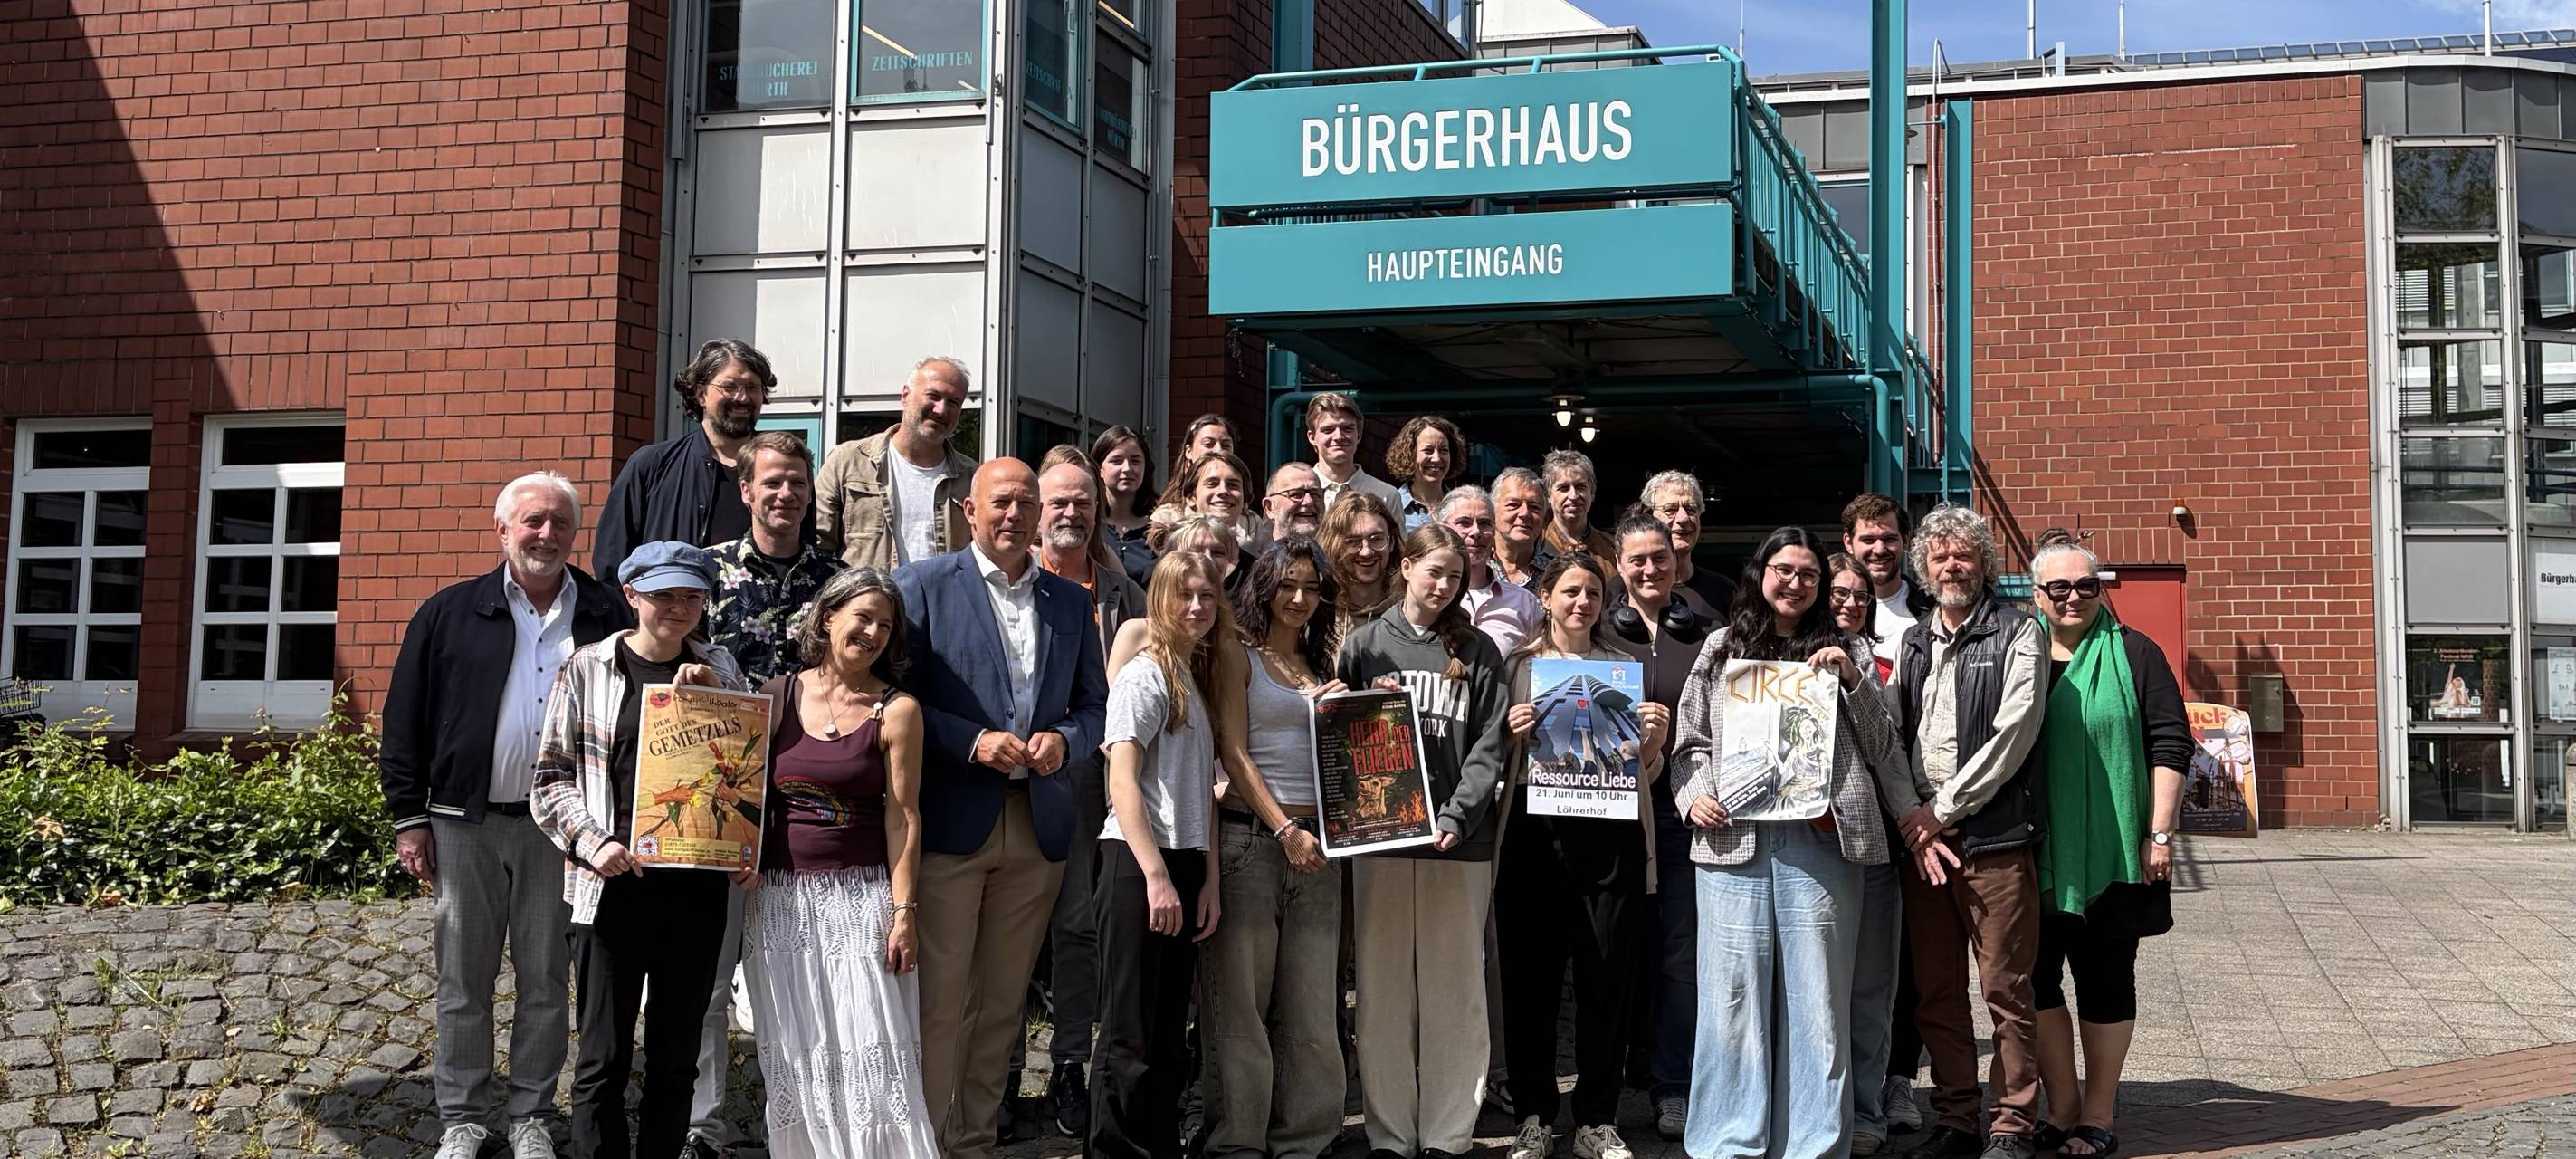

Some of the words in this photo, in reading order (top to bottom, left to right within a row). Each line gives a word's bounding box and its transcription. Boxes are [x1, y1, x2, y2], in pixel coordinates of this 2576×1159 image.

[872, 51, 973, 71] ZEITSCHRIFTEN
[1302, 100, 1632, 177] BÜRGERHAUS
[1368, 244, 1563, 283] HAUPTEINGANG
[2541, 572, 2576, 585] Bürgerh
[1730, 664, 1818, 706] CIRCE
[654, 718, 670, 728] DER
[656, 724, 678, 736] GOTT
[1350, 719, 1390, 746] HERR
[1392, 724, 1411, 742] DER
[649, 716, 742, 757] GEMETZELS
[1351, 742, 1415, 775] FLIEGEN
[1532, 769, 1598, 787] Ressource
[1601, 771, 1636, 789] Liebe
[1536, 789, 1550, 798] 21.
[1553, 790, 1573, 799] Juni
[1596, 791, 1607, 800] 10
[1609, 791, 1628, 801] Uhr
[1557, 805, 1607, 816] Löhrerhof
